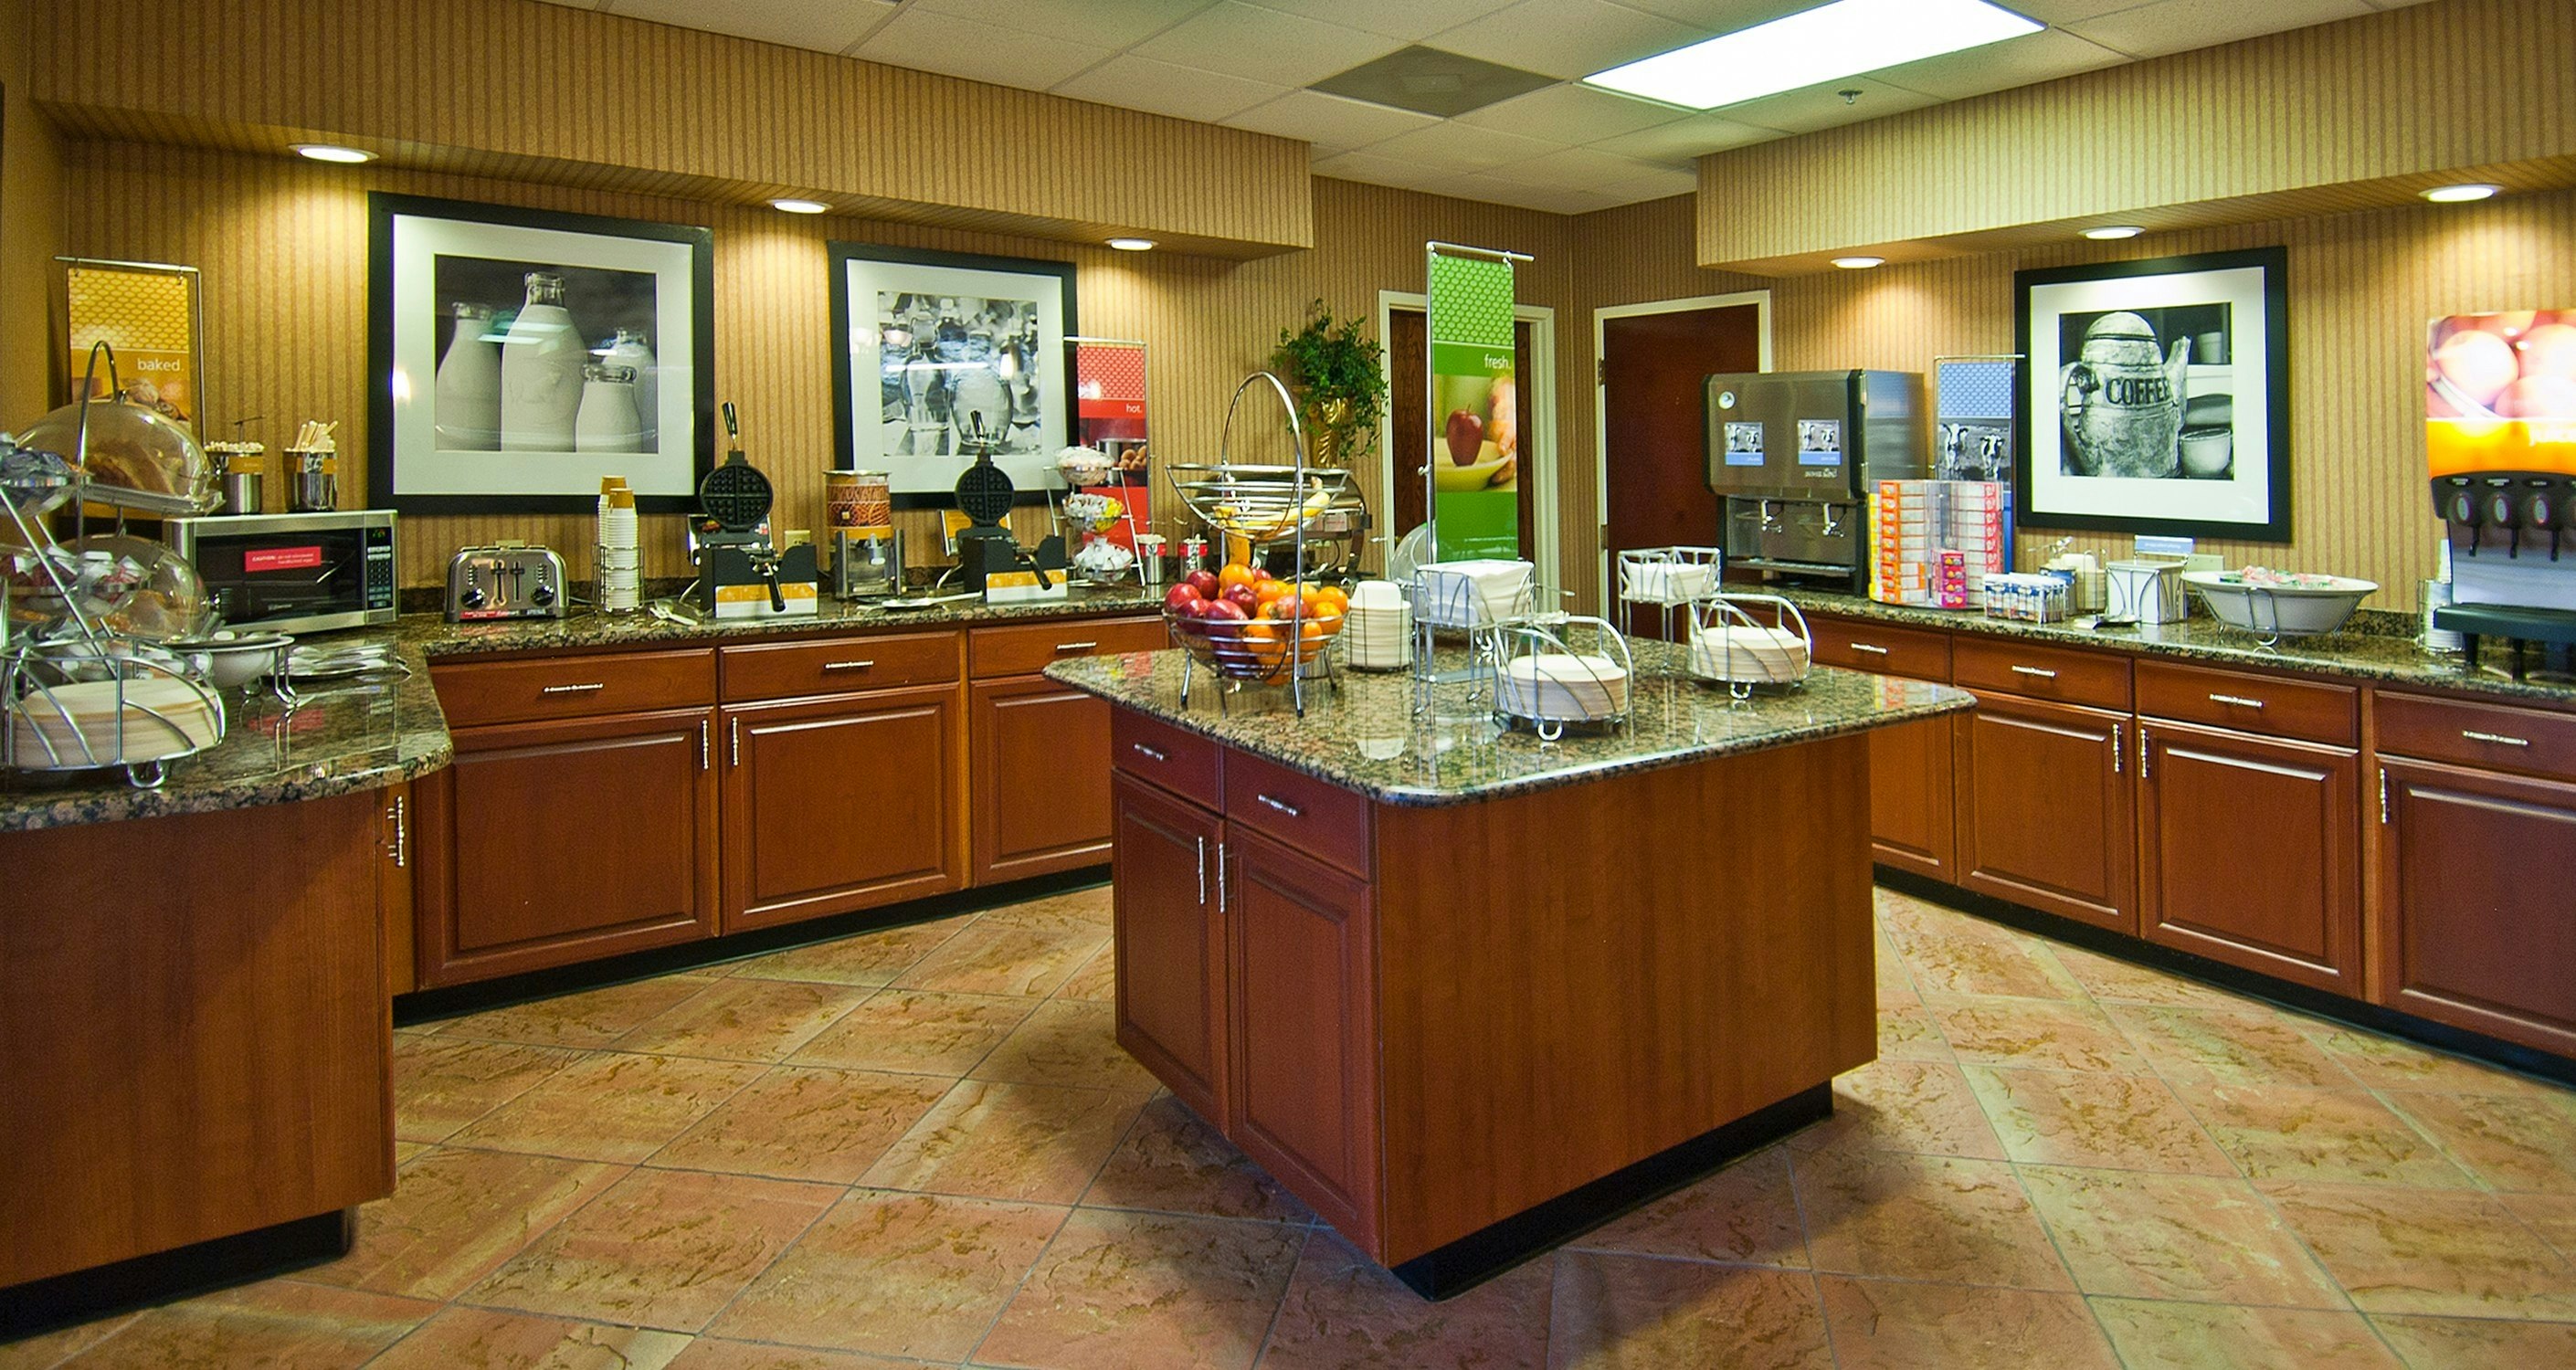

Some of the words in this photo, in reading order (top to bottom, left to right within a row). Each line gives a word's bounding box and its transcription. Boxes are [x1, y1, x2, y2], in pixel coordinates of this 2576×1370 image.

[137, 357, 185, 372] baked.
[1483, 353, 1512, 369] fresh.
[2106, 376, 2170, 405] COFFEE
[1125, 403, 1143, 414] hot.
